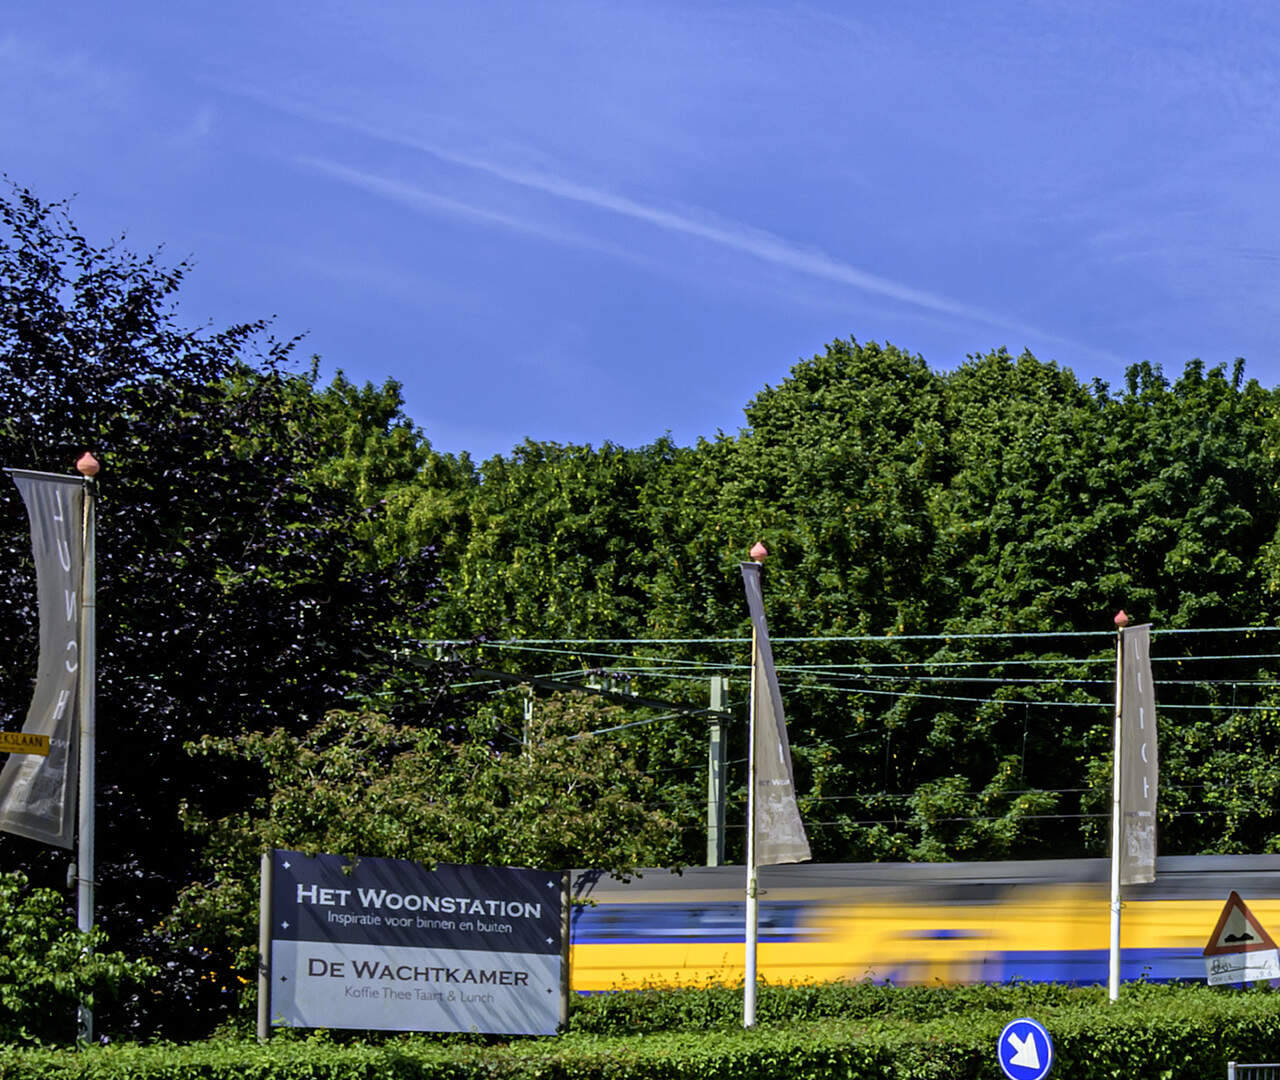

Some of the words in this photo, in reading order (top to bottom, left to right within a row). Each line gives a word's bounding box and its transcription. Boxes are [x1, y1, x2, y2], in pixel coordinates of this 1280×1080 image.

[328, 910, 381, 927] Inspiratie
[385, 916, 414, 927] voor
[416, 915, 455, 930] binnen
[459, 922, 473, 931] en
[477, 919, 512, 933] buiten
[344, 986, 380, 999] Koffie
[382, 987, 412, 1000] Thee
[414, 988, 443, 1001] Taart
[446, 990, 456, 1002] &
[460, 991, 494, 1003] Lunch
